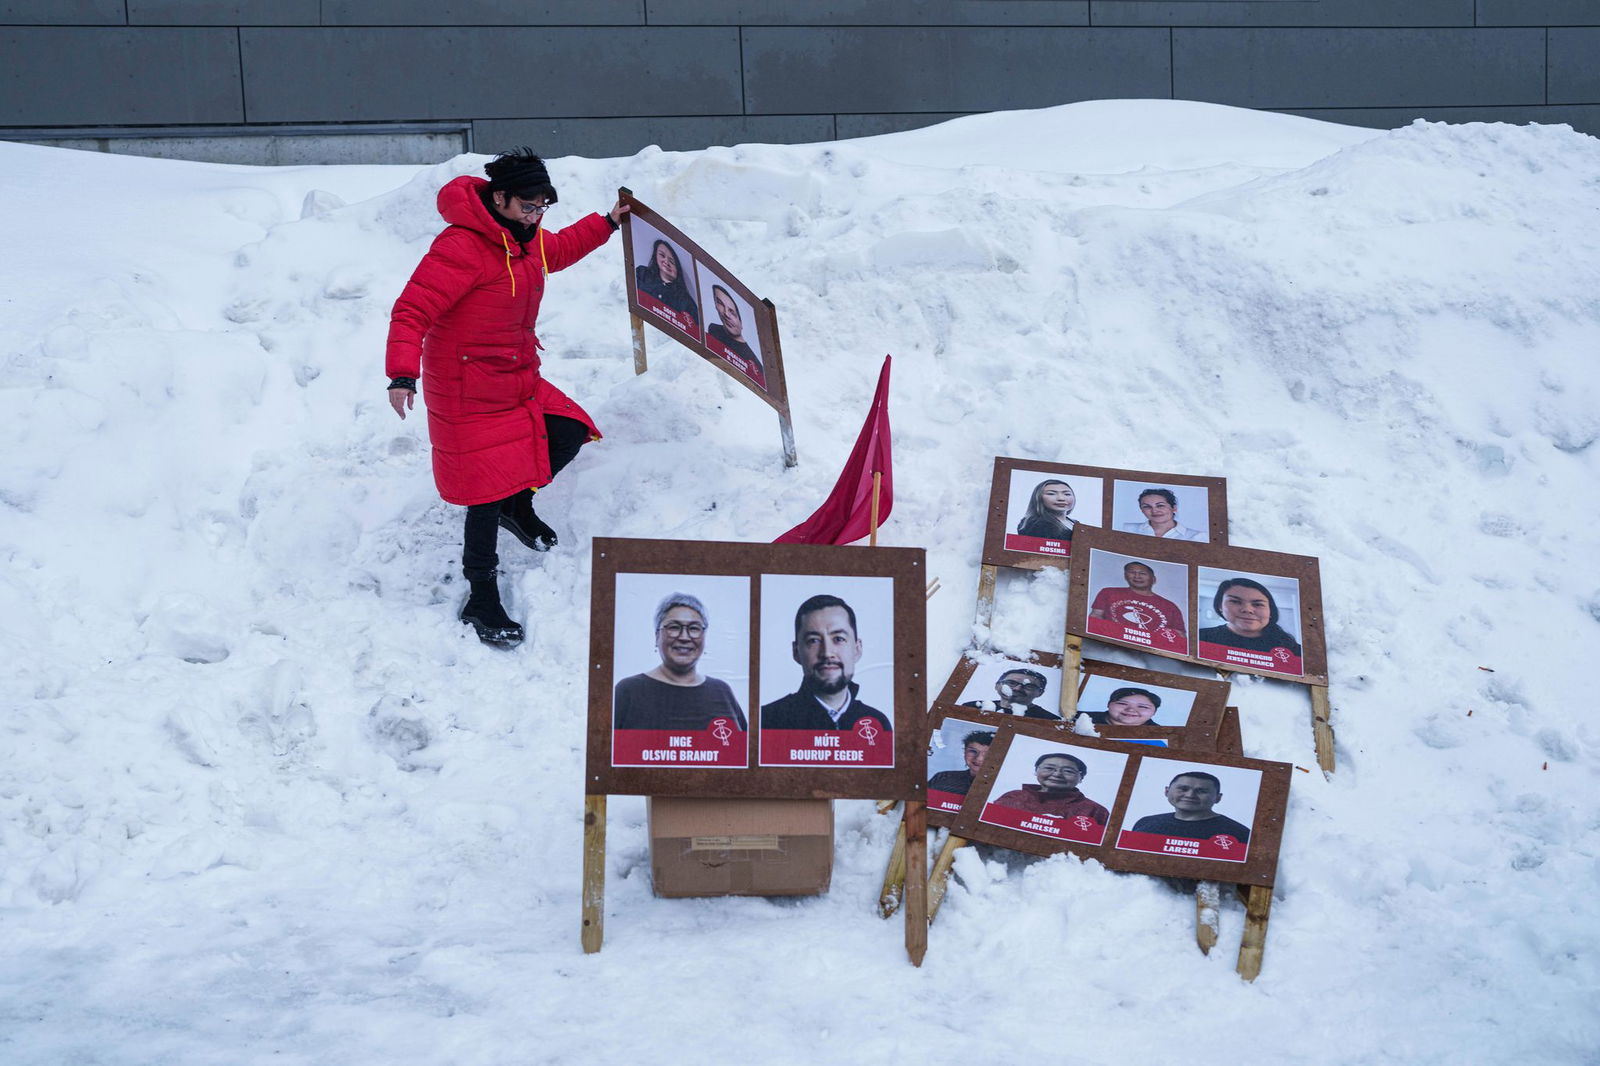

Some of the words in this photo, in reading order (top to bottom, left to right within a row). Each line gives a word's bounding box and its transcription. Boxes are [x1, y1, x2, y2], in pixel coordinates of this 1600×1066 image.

[1040, 546, 1066, 554] ROSING
[1124, 627, 1151, 638] TOBIAS
[1123, 634, 1152, 645] BIANCO
[1250, 659, 1275, 668] BIANCO
[669, 736, 693, 747] INGE
[814, 733, 841, 747] MÚTE
[642, 749, 677, 761] OLSVIG
[679, 750, 719, 761] BRANDT
[790, 749, 832, 761] BOURUP
[834, 750, 864, 761] EGEDE
[1031, 816, 1054, 826] MIMI
[1020, 820, 1060, 834] KARLSEN
[1165, 838, 1200, 848] LUDVIG
[1163, 845, 1199, 855] LARSEN
